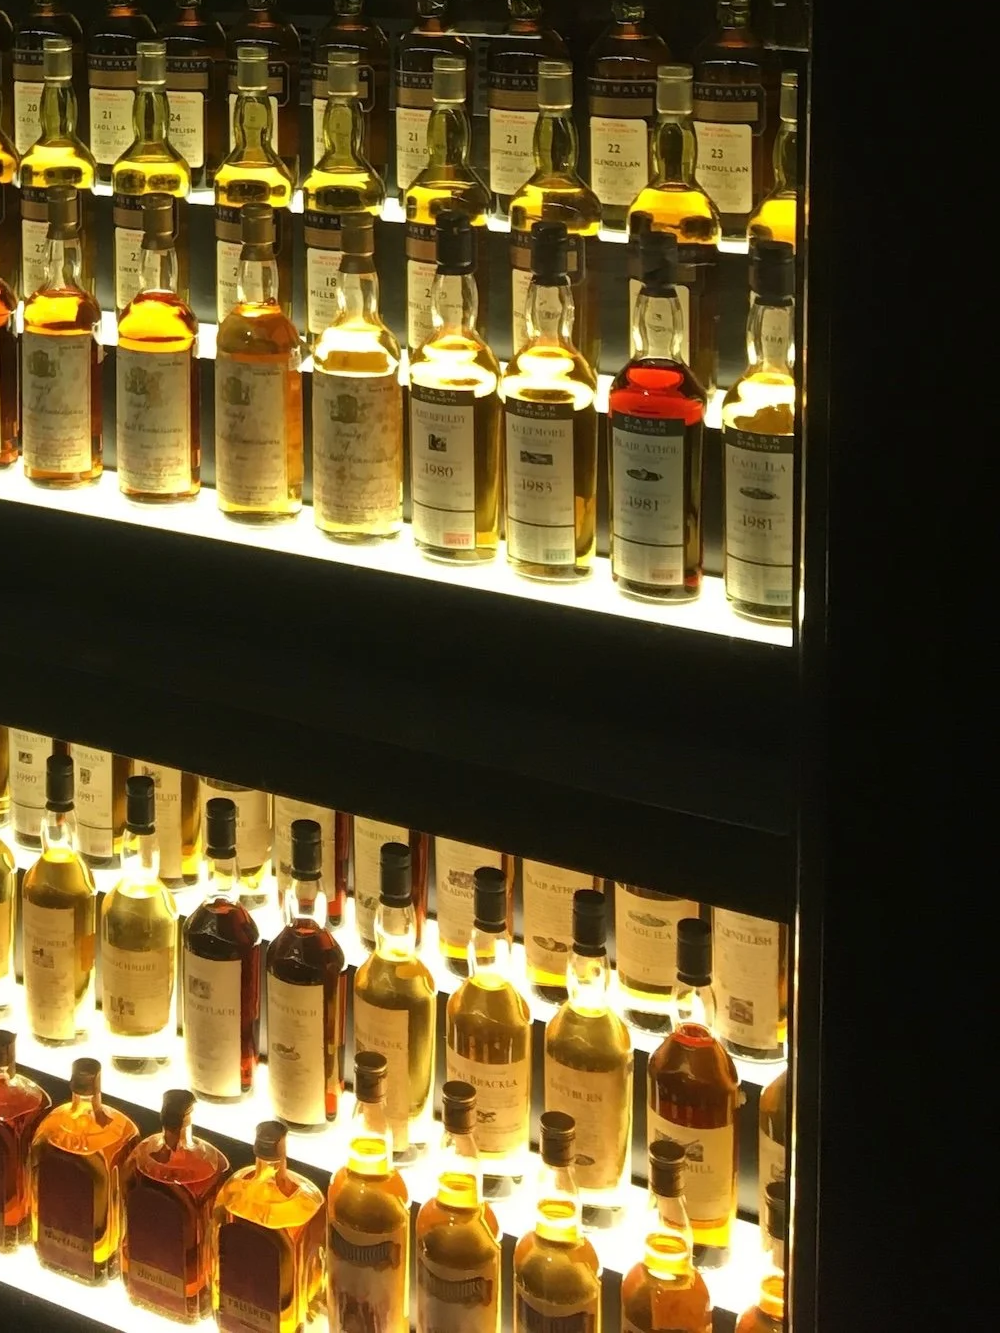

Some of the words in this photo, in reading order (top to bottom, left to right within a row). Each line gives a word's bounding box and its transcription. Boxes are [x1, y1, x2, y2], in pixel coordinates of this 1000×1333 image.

[607, 143, 621, 154] 22
[711, 149, 724, 159] 23
[326, 277, 337, 287] 18
[424, 462, 455, 479] 1980
[521, 478, 553, 493] 1983
[628, 495, 661, 512] 1981
[741, 514, 774, 531] 1981
